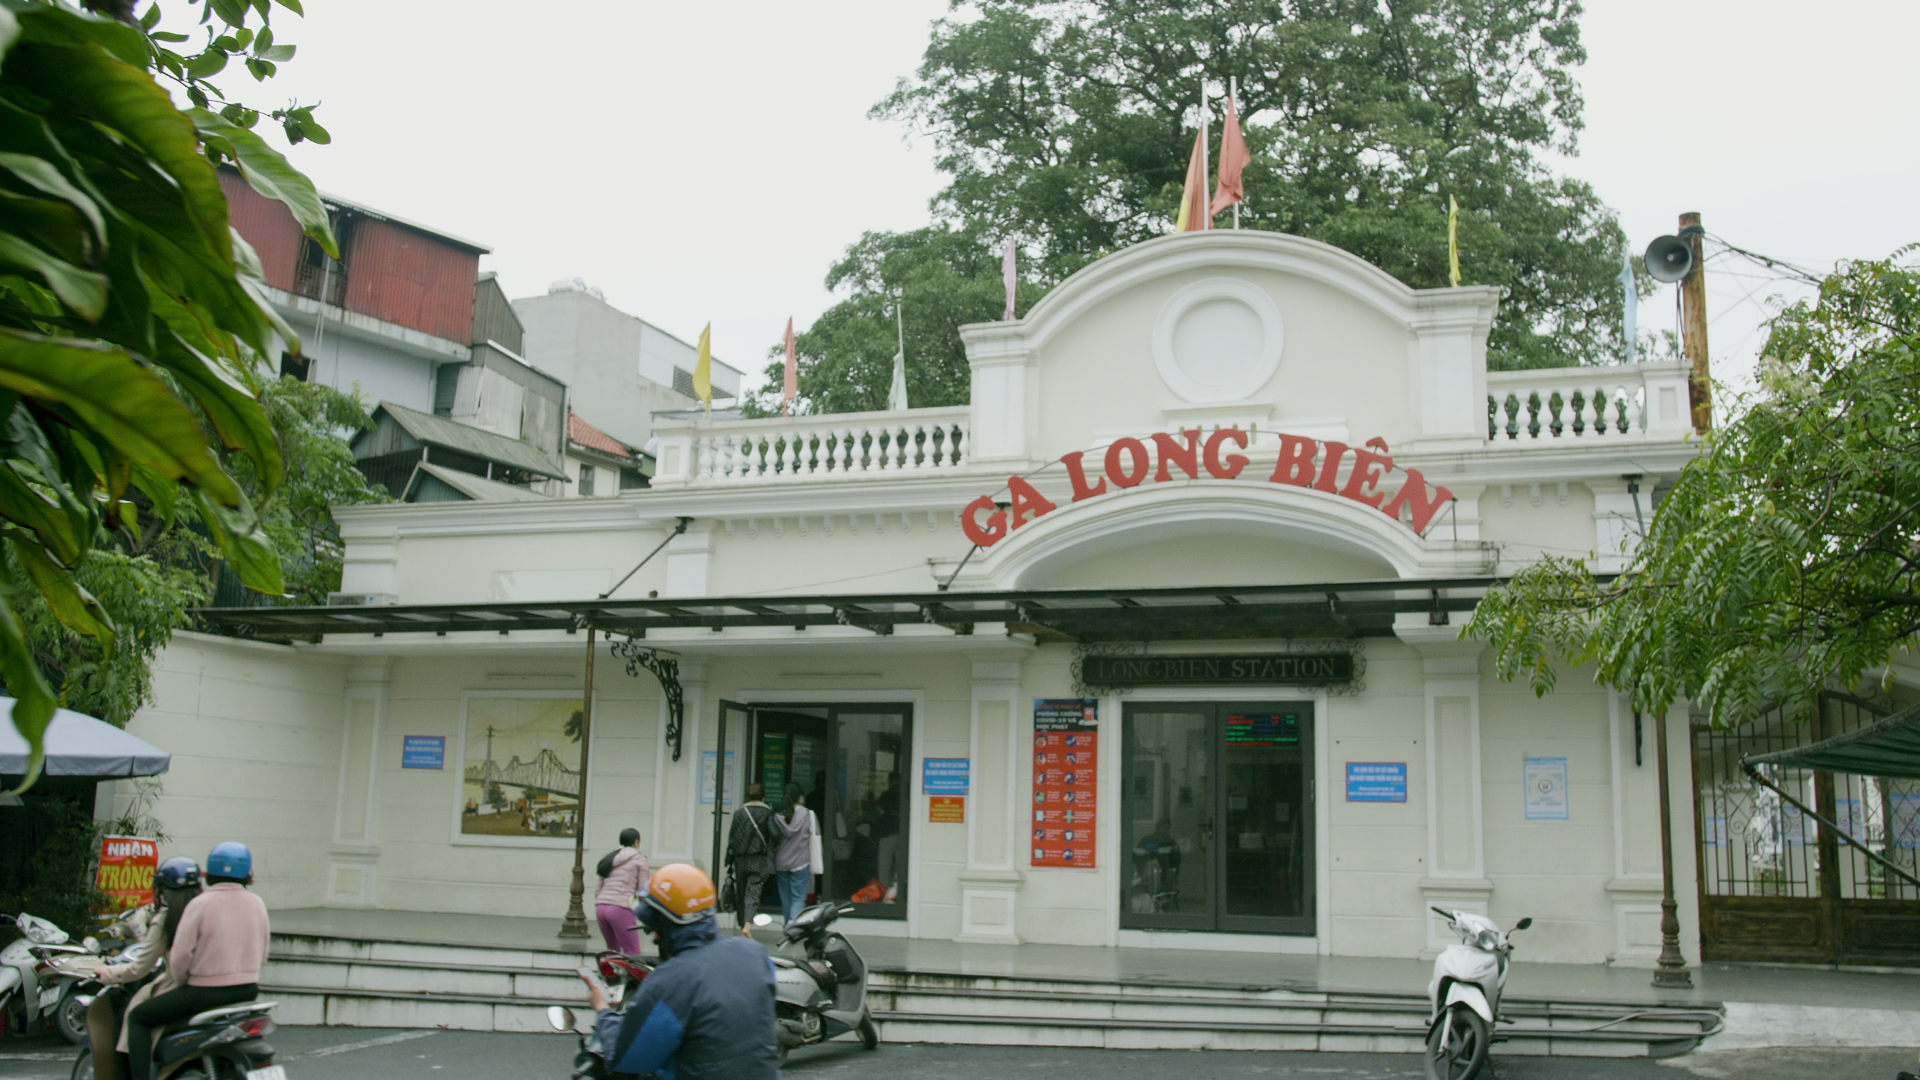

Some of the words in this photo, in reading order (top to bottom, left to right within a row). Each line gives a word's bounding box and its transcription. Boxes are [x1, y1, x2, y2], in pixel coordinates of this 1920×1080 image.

[961, 475, 1056, 547] GA
[1061, 428, 1250, 503] LONG
[1270, 434, 1456, 535] BIÊN
[1231, 657, 1336, 678] STATION
[108, 842, 153, 858] NHẬN
[100, 859, 154, 890] TRÔNG
